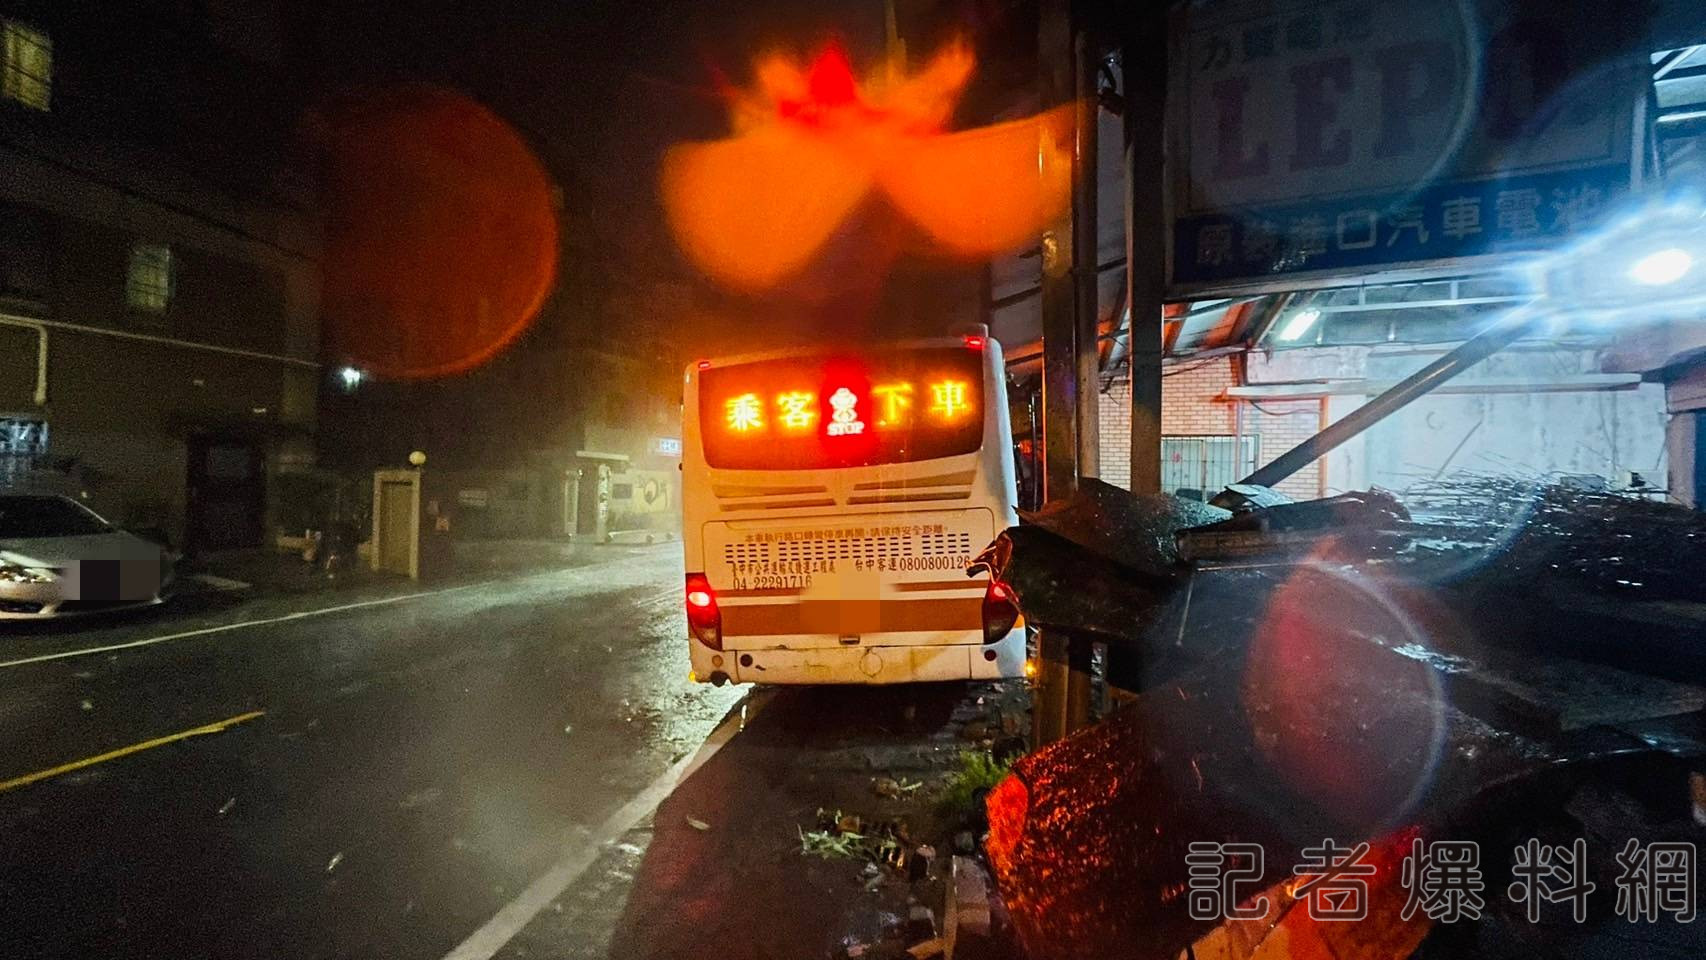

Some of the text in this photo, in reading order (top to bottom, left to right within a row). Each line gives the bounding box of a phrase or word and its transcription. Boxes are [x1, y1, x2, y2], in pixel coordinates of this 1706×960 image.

[725, 388, 817, 431] 乘客
[873, 378, 968, 427] 下車
[826, 421, 865, 436] STOP
